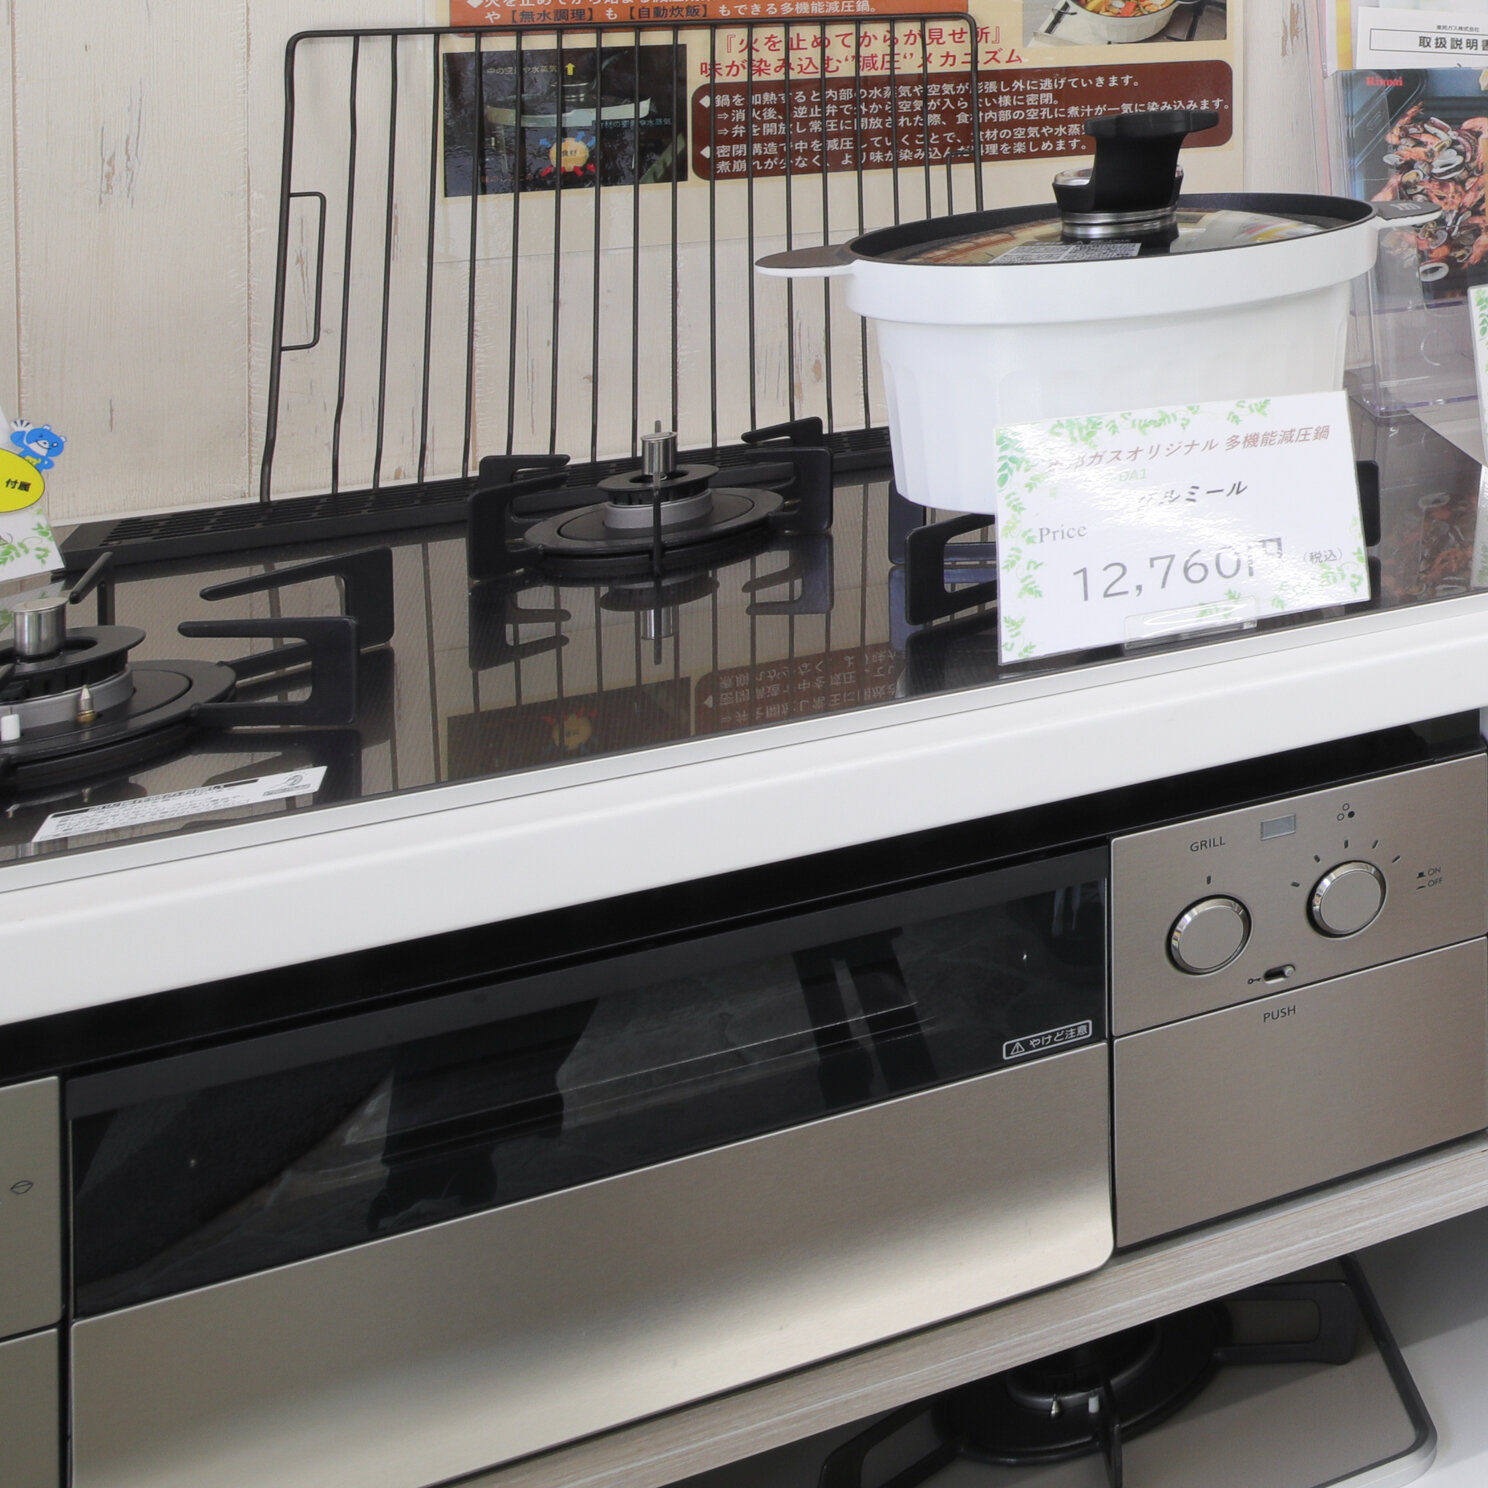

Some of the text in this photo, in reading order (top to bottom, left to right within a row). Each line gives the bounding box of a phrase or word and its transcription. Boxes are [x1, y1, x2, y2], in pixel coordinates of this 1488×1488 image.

[1366, 76, 1403, 87] Rinnai
[1224, 424, 1330, 451] 多機能減圧鍋
[5, 478, 31, 493] 付属
[1038, 524, 1087, 544] Price
[1189, 836, 1226, 852] GRILL
[1427, 865, 1442, 876] ON
[1427, 876, 1443, 888] OFF
[1262, 1006, 1297, 1024] PUSH
[1029, 1022, 1090, 1049] やけど注意
